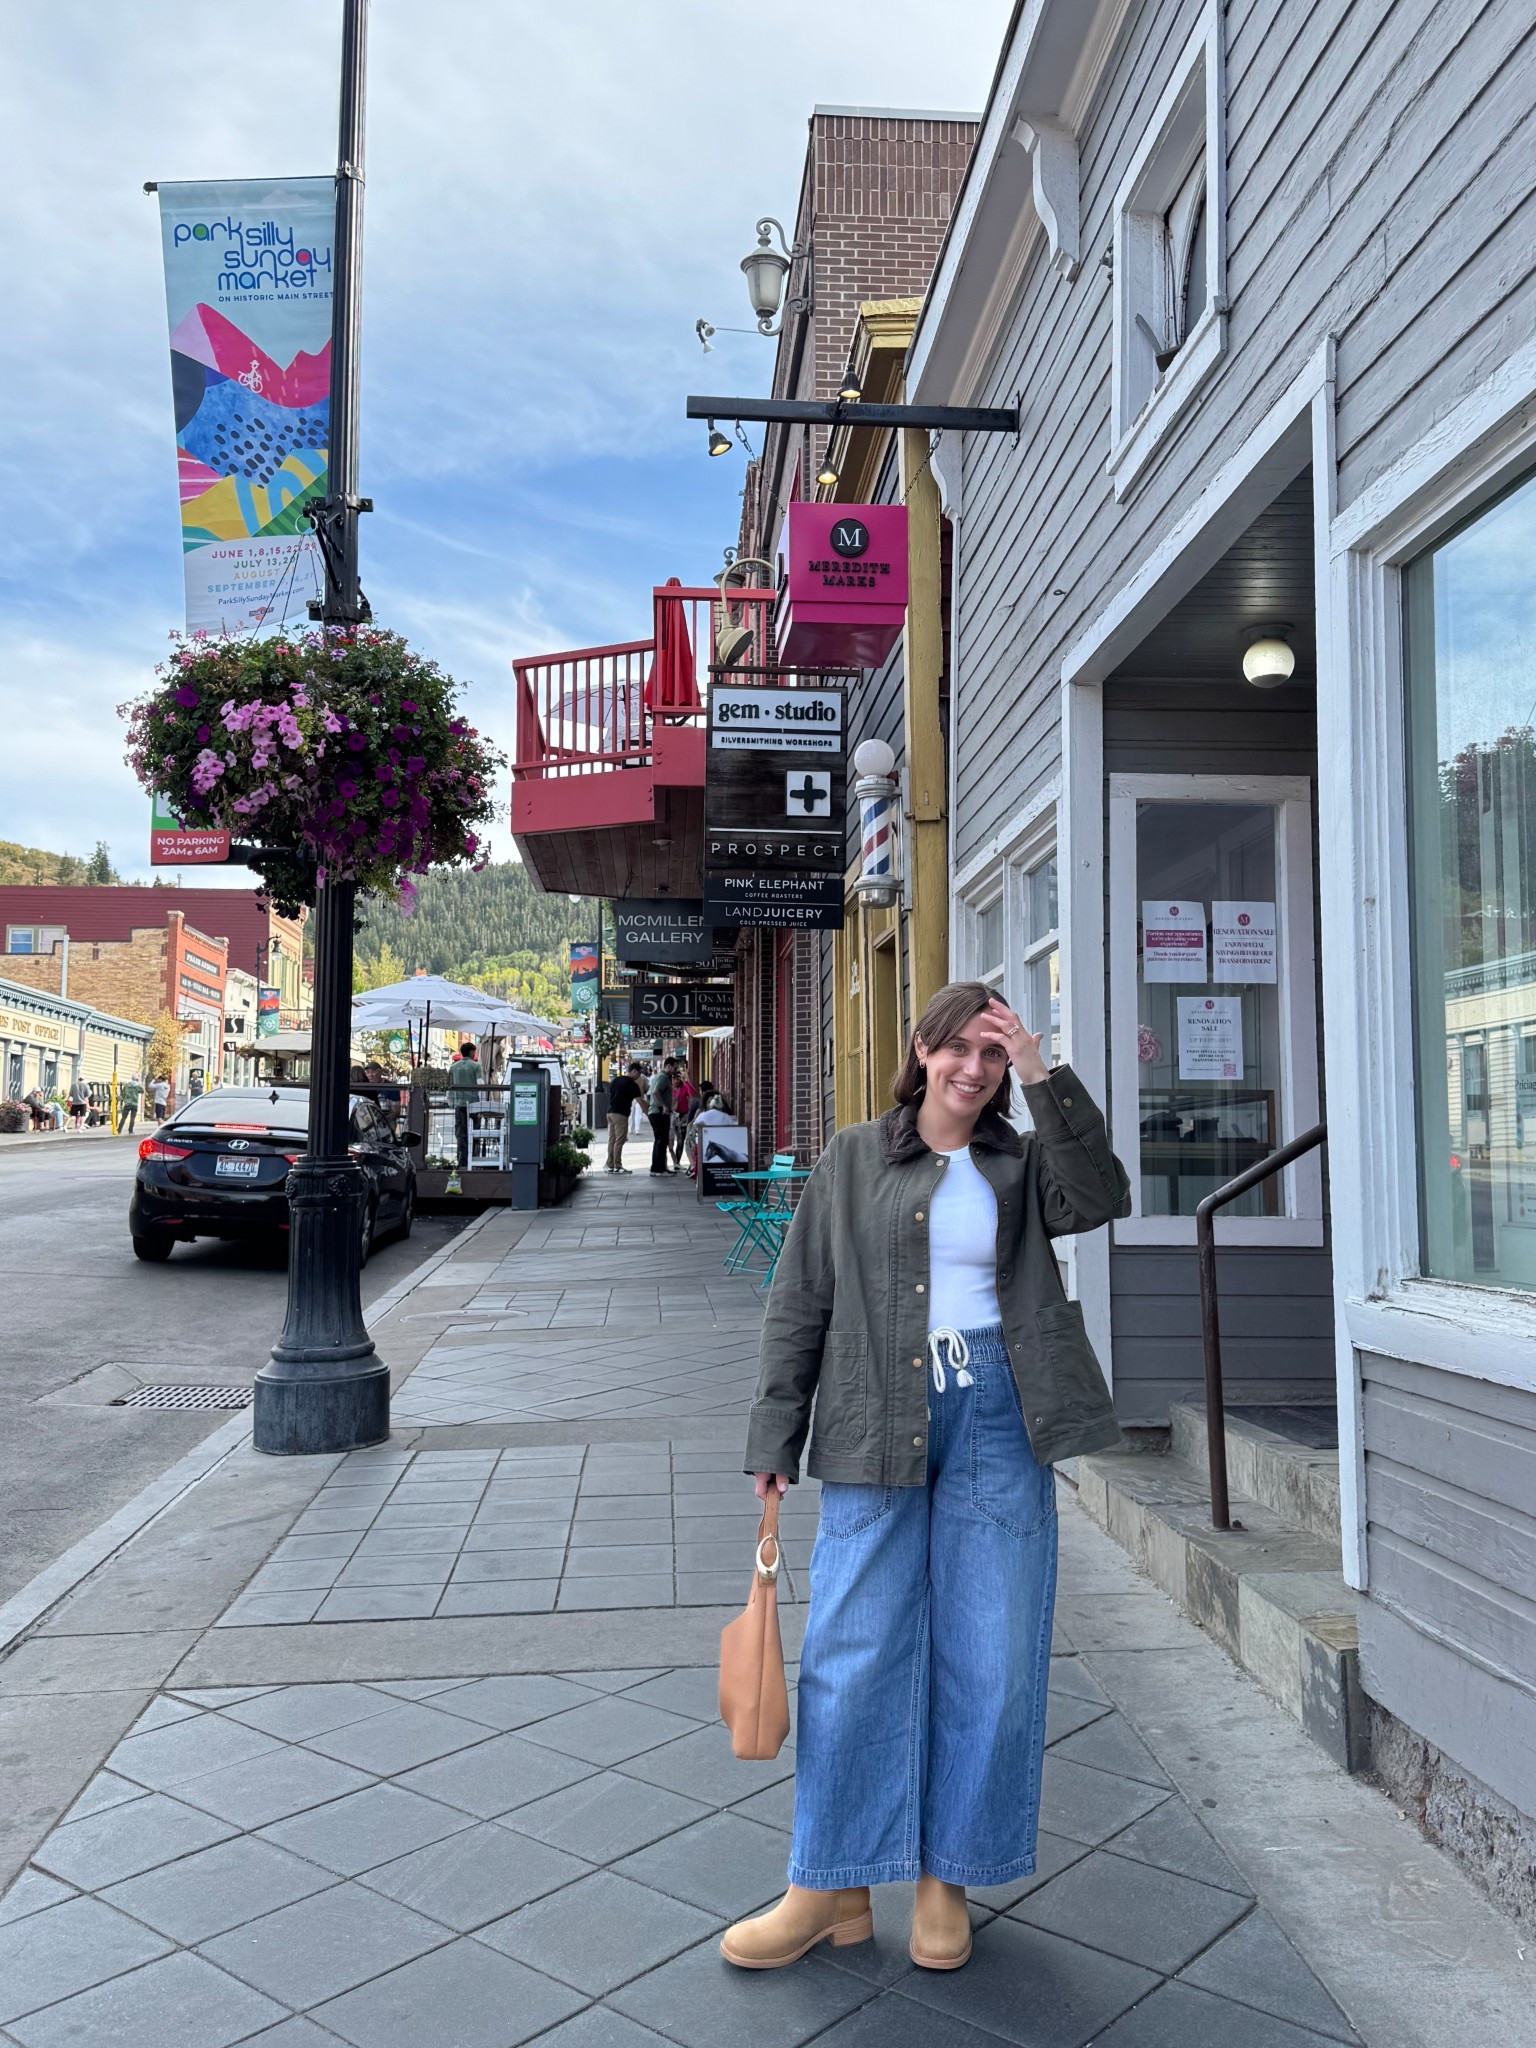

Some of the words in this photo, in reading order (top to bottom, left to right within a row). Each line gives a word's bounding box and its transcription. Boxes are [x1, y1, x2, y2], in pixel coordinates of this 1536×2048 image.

[173, 216, 243, 248] park
[246, 221, 295, 248] silly
[224, 247, 332, 272] sunday
[217, 269, 317, 291] market
[233, 294, 274, 302] HISTORIC
[277, 293, 300, 301] MAIN
[302, 291, 334, 299] STREET
[837, 527, 863, 547] M
[211, 549, 244, 559] JUNE
[233, 559, 262, 569] JULY
[808, 560, 891, 574] MEREDITH
[233, 568, 280, 580] AUGUST
[207, 580, 276, 593] SEPTEMBER
[822, 574, 876, 588] MARKS
[718, 703, 760, 722] gem
[774, 700, 837, 722] studio
[720, 736, 783, 745] SILVERSMITHING
[785, 738, 833, 747] WORKSHOPS
[157, 837, 174, 846] NO
[177, 836, 225, 846] PARKING
[162, 847, 186, 856] 2AM
[194, 846, 218, 855] 6AM
[711, 842, 840, 857] PROSPECT
[724, 878, 754, 889] PINK
[759, 878, 825, 891] ELEPHANT
[725, 906, 823, 919] LANDJUICERY
[625, 931, 704, 943] GALLERY
[641, 993, 693, 1015] 501
[716, 993, 735, 1003] MA
[12, 1018, 32, 1034] POST
[34, 1024, 59, 1040] OFFICE
[634, 1030, 682, 1038] BURGER
